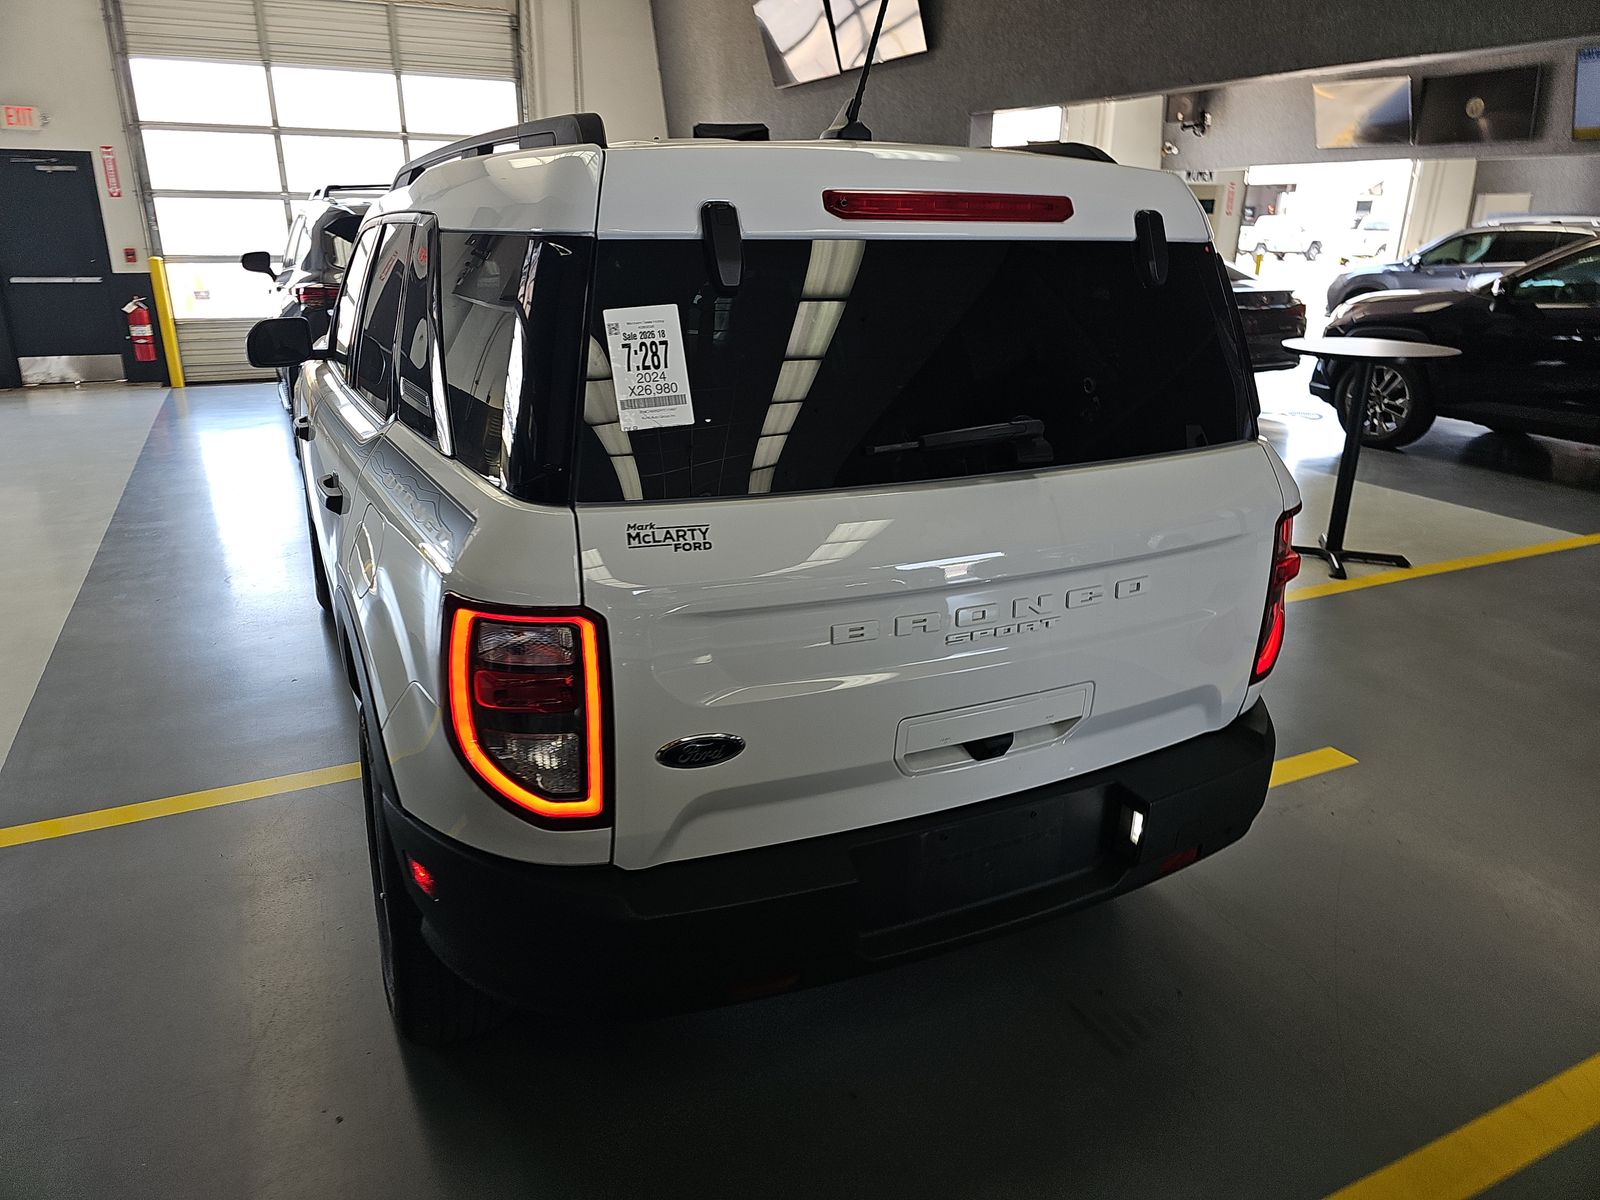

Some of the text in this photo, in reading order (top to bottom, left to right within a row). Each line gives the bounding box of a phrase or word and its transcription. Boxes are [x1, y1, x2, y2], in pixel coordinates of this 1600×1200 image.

[4, 106, 33, 127] EXIT
[622, 329, 666, 341] Sale 2026 18
[636, 371, 667, 384] 2024
[628, 382, 679, 397] X26,980
[626, 522, 656, 531] Mark
[626, 527, 710, 545] McLARTY
[674, 541, 713, 552] FORD
[830, 575, 1149, 646] BRONCO
[945, 616, 1061, 646] SPORT
[678, 742, 726, 764] Ford
